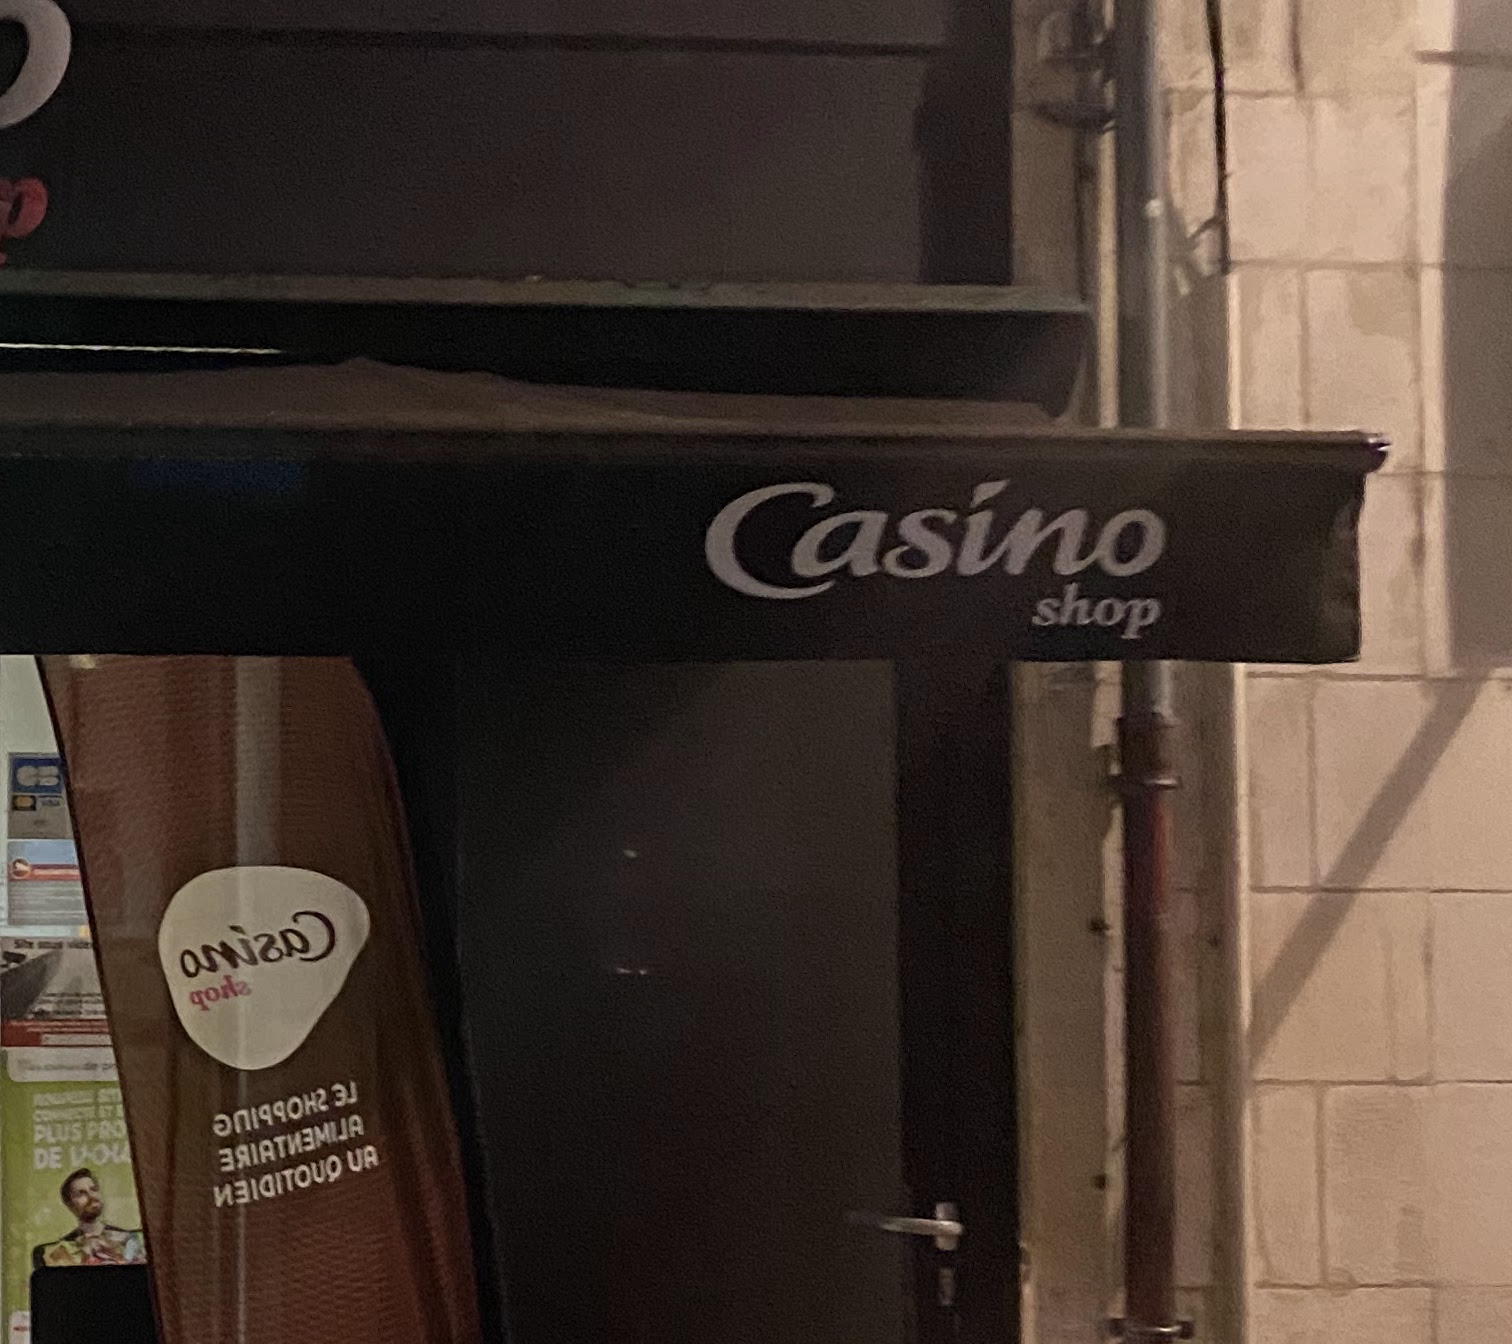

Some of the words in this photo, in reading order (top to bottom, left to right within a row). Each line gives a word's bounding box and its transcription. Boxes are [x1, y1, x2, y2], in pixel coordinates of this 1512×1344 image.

[704, 479, 1167, 600] Casino
[1031, 581, 1162, 640] shop
[34, 1147, 63, 1170] DE
